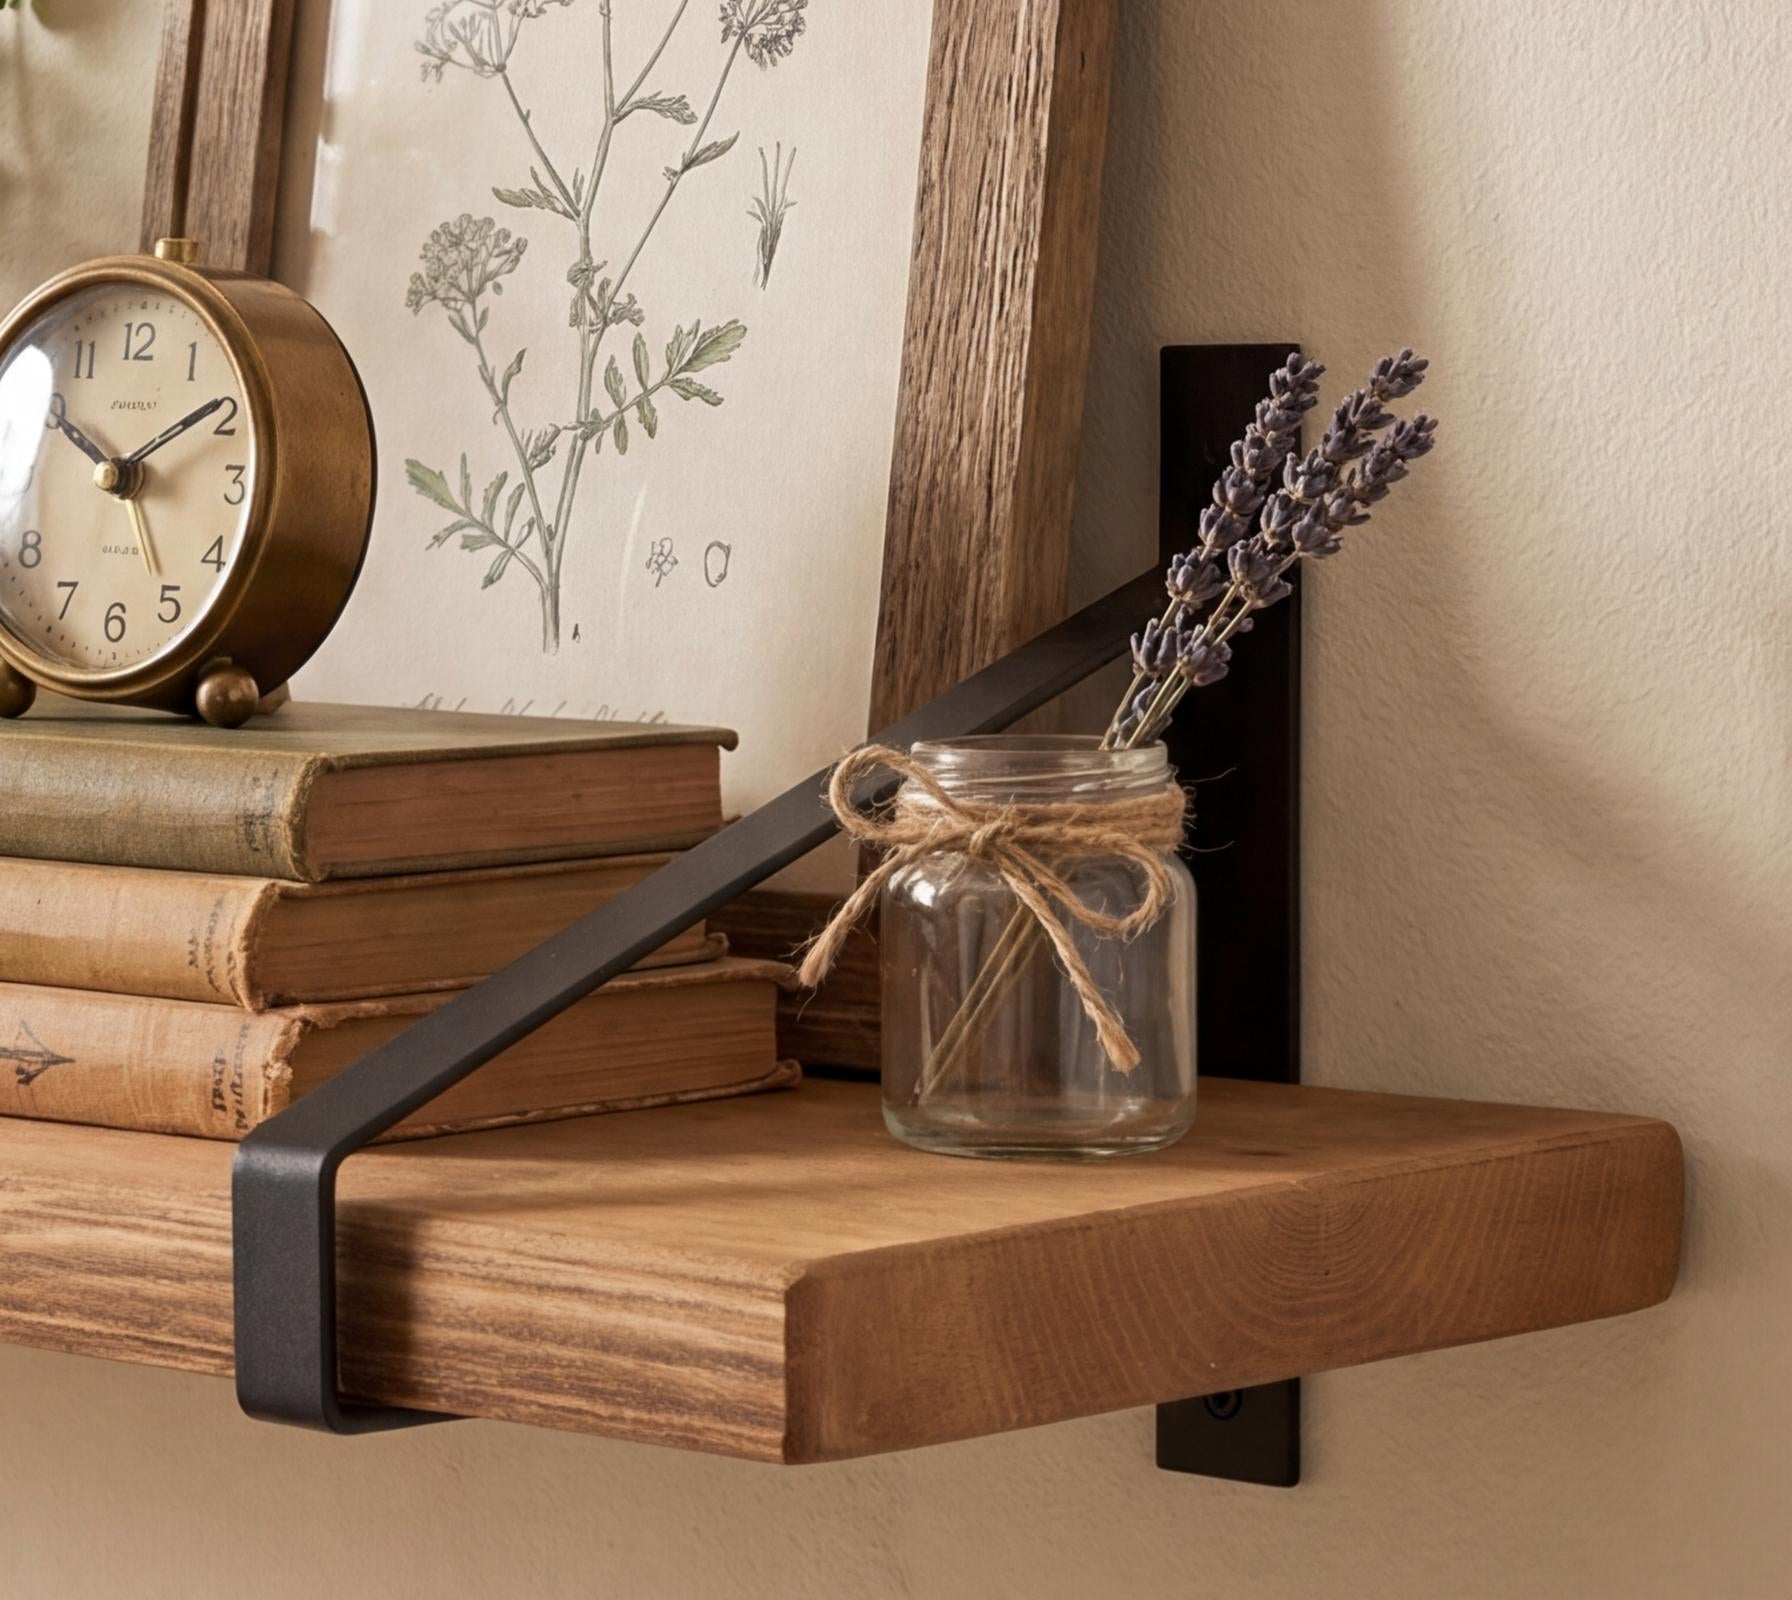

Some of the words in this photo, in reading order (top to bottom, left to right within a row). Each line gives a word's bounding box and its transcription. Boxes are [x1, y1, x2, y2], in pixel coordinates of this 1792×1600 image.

[74, 339, 96, 379] 11
[122, 322, 156, 361] 12
[187, 341, 197, 382] 1
[213, 396, 238, 436] 2
[223, 464, 246, 505] 3
[18, 530, 42, 568] 8
[201, 535, 226, 573] 4
[57, 581, 79, 620] 7
[157, 585, 182, 623] 5
[104, 602, 127, 642] 6
